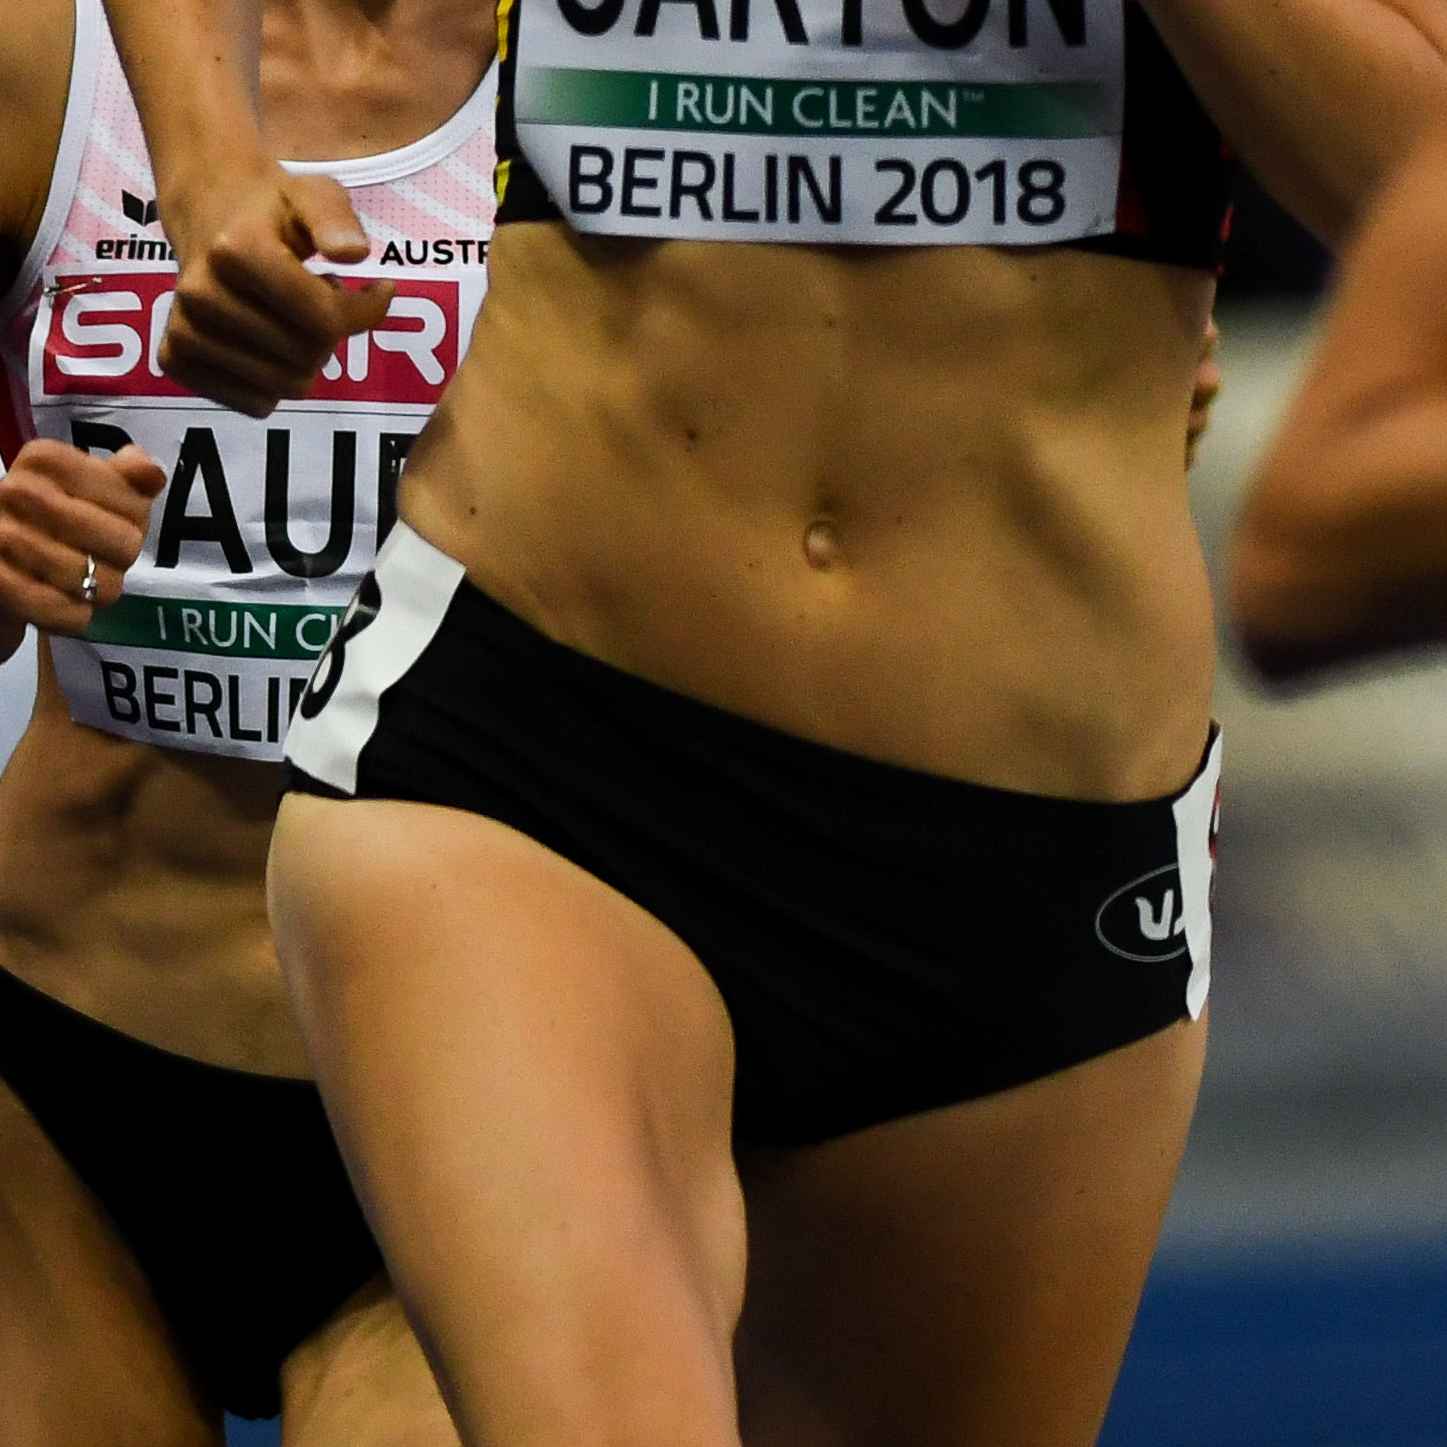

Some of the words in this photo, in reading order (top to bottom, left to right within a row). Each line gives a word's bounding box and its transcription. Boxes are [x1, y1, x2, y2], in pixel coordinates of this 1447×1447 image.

[648, 81, 658, 120] I
[676, 82, 774, 126] RUN
[569, 144, 842, 224] BERLIN
[874, 158, 1067, 226] 2018
[56, 291, 445, 385] SR
[157, 606, 167, 640] I
[181, 608, 277, 650] RUN
